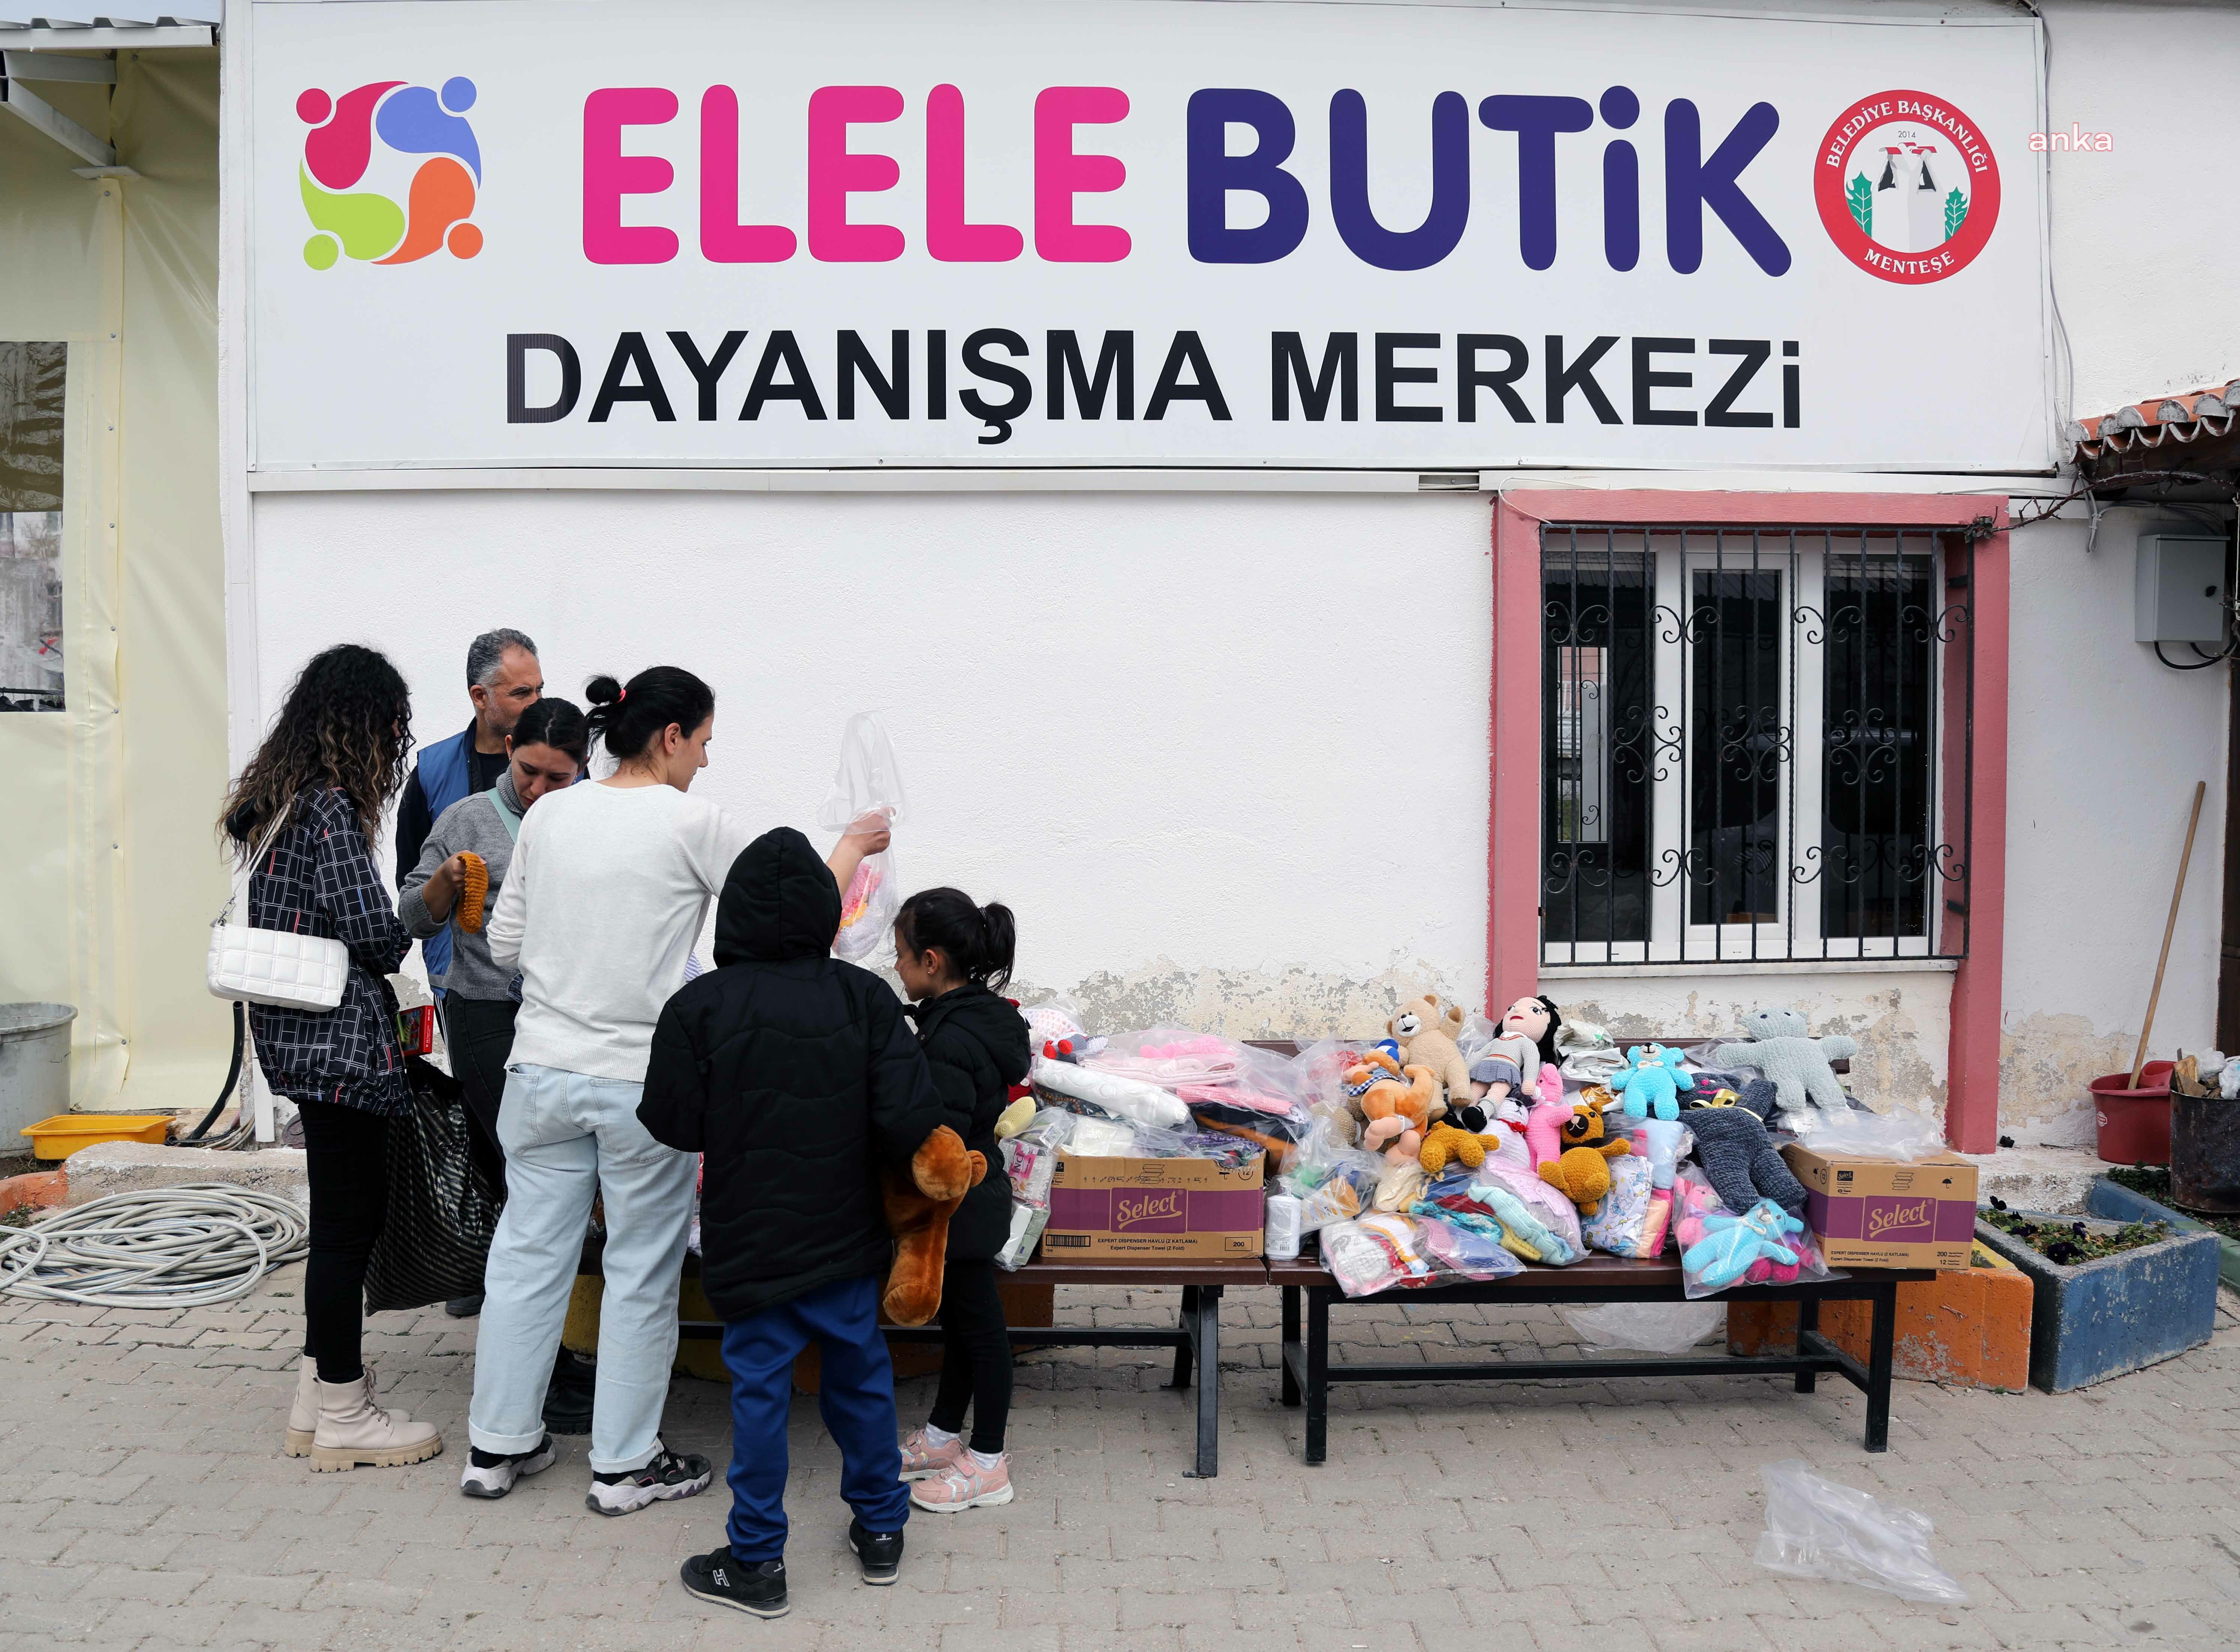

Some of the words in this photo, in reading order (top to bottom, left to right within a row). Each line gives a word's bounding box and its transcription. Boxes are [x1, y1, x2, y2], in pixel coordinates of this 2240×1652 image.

[1827, 102, 1892, 168] BELEDİYE
[1898, 101, 1987, 172] BAŞKANLIĞI
[583, 84, 1131, 264] ELELE
[1864, 249, 1954, 274] MENTEŞE
[507, 328, 1232, 444] DAYANIŞMA
[1117, 1191, 1177, 1222] Select
[1869, 1200, 1927, 1230] Select
